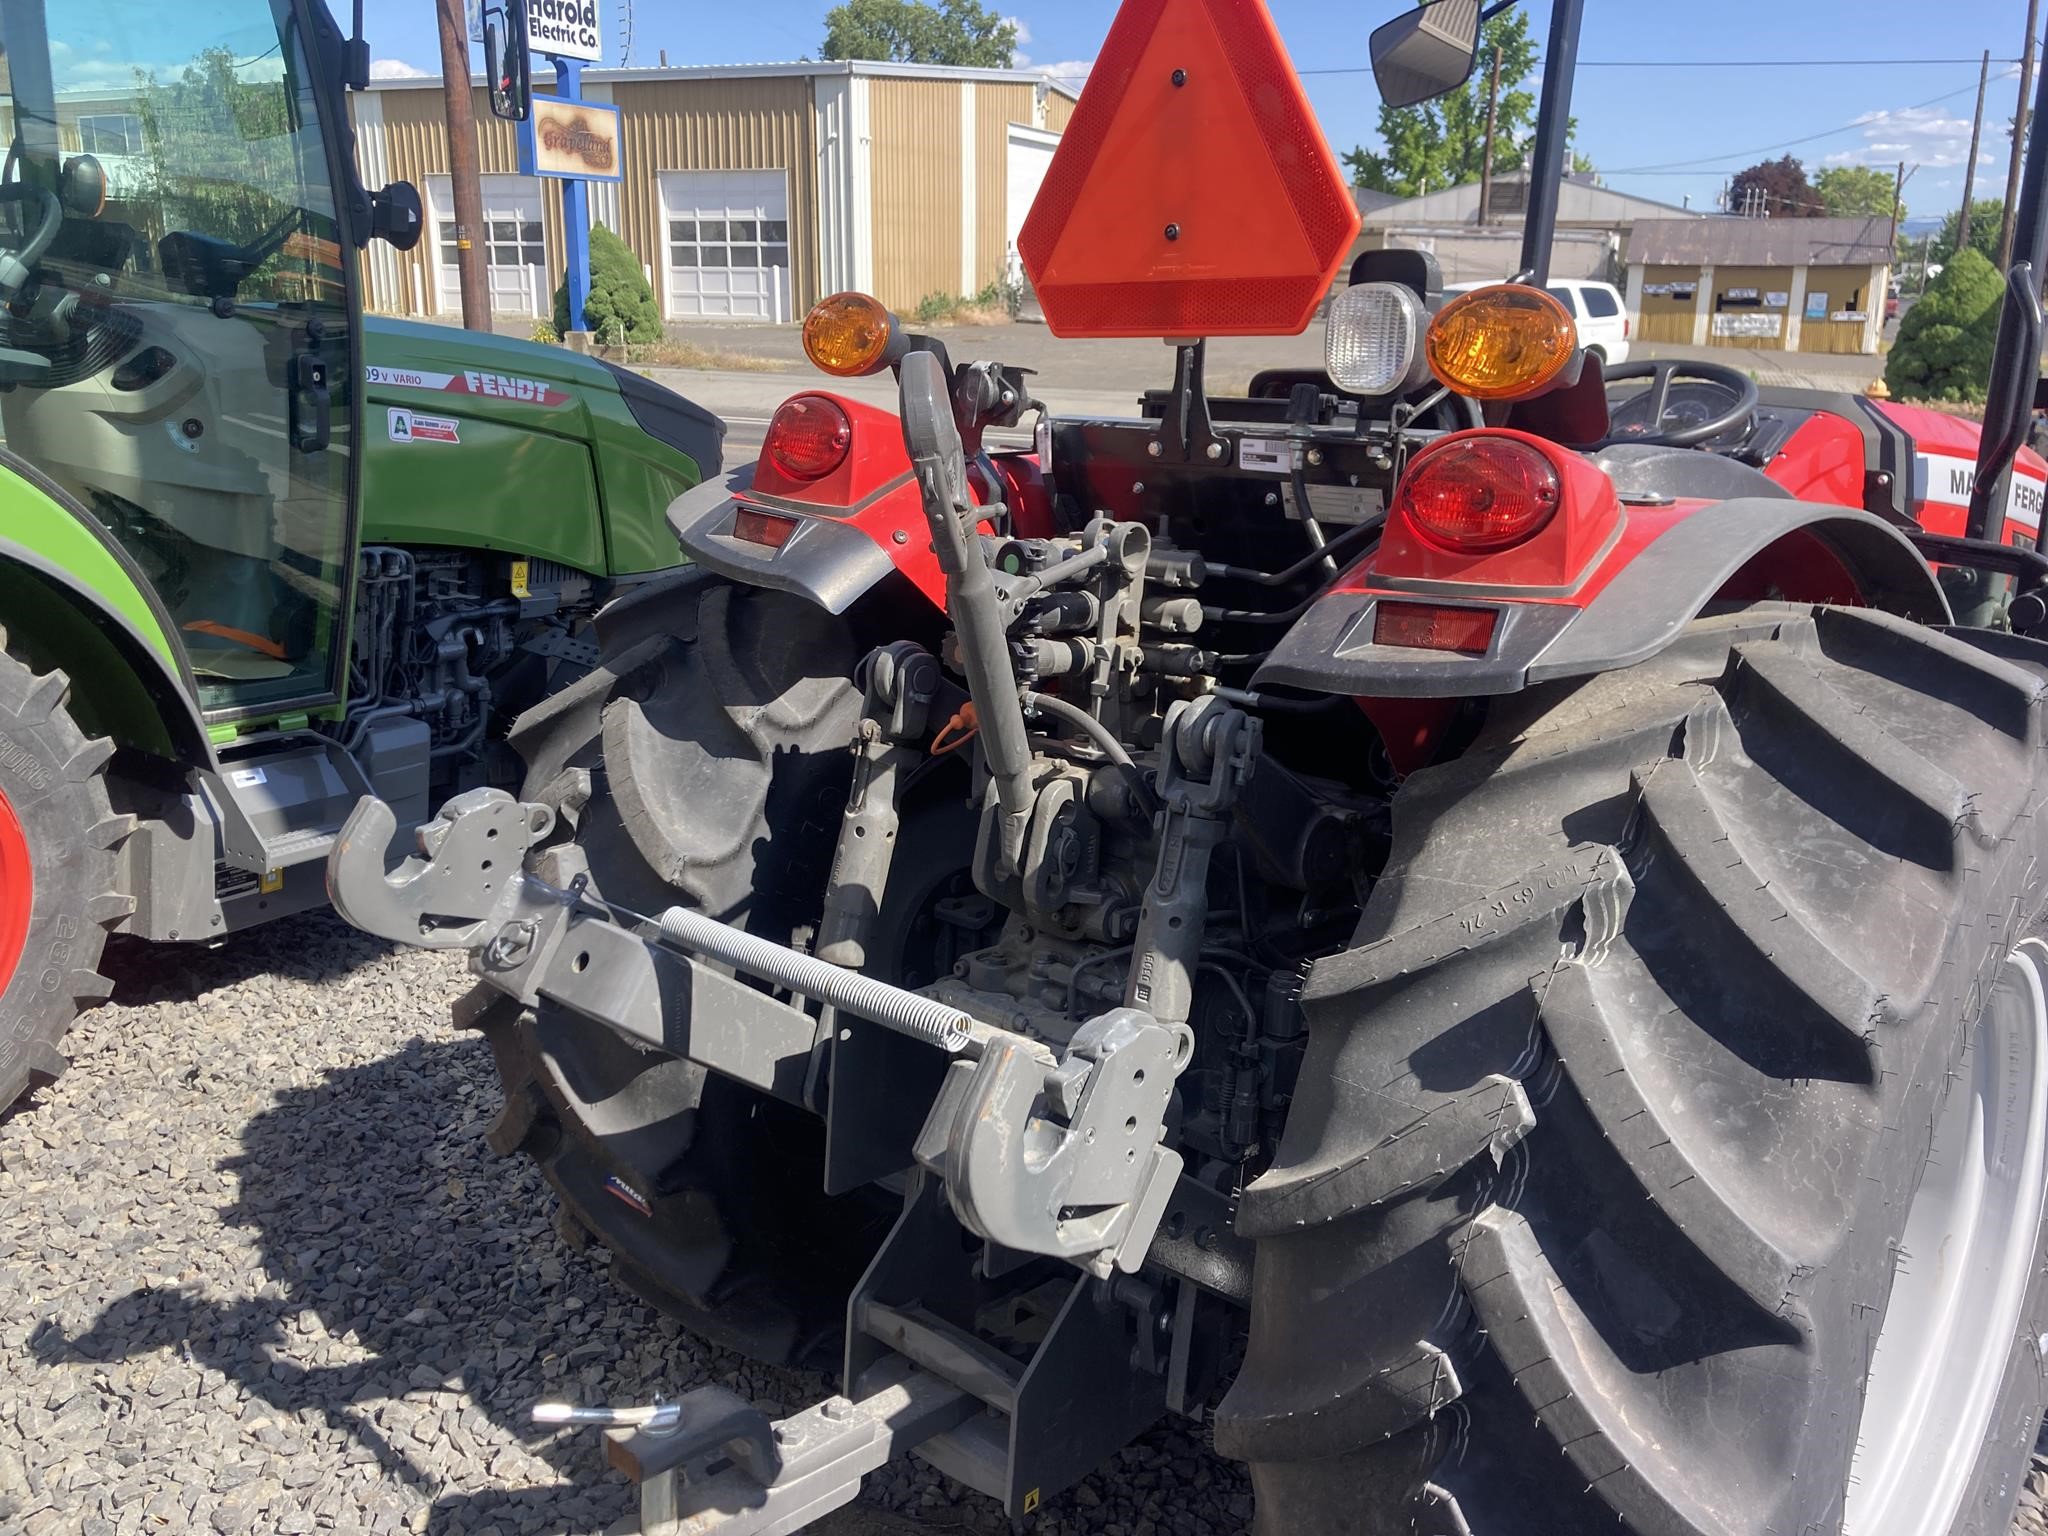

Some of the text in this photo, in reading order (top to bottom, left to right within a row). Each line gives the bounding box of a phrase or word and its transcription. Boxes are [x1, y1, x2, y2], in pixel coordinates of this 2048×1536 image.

[529, 17, 598, 48] Electric Co.
[381, 372, 388, 382] V
[393, 373, 422, 385] VARIO
[464, 370, 550, 402] FENDT
